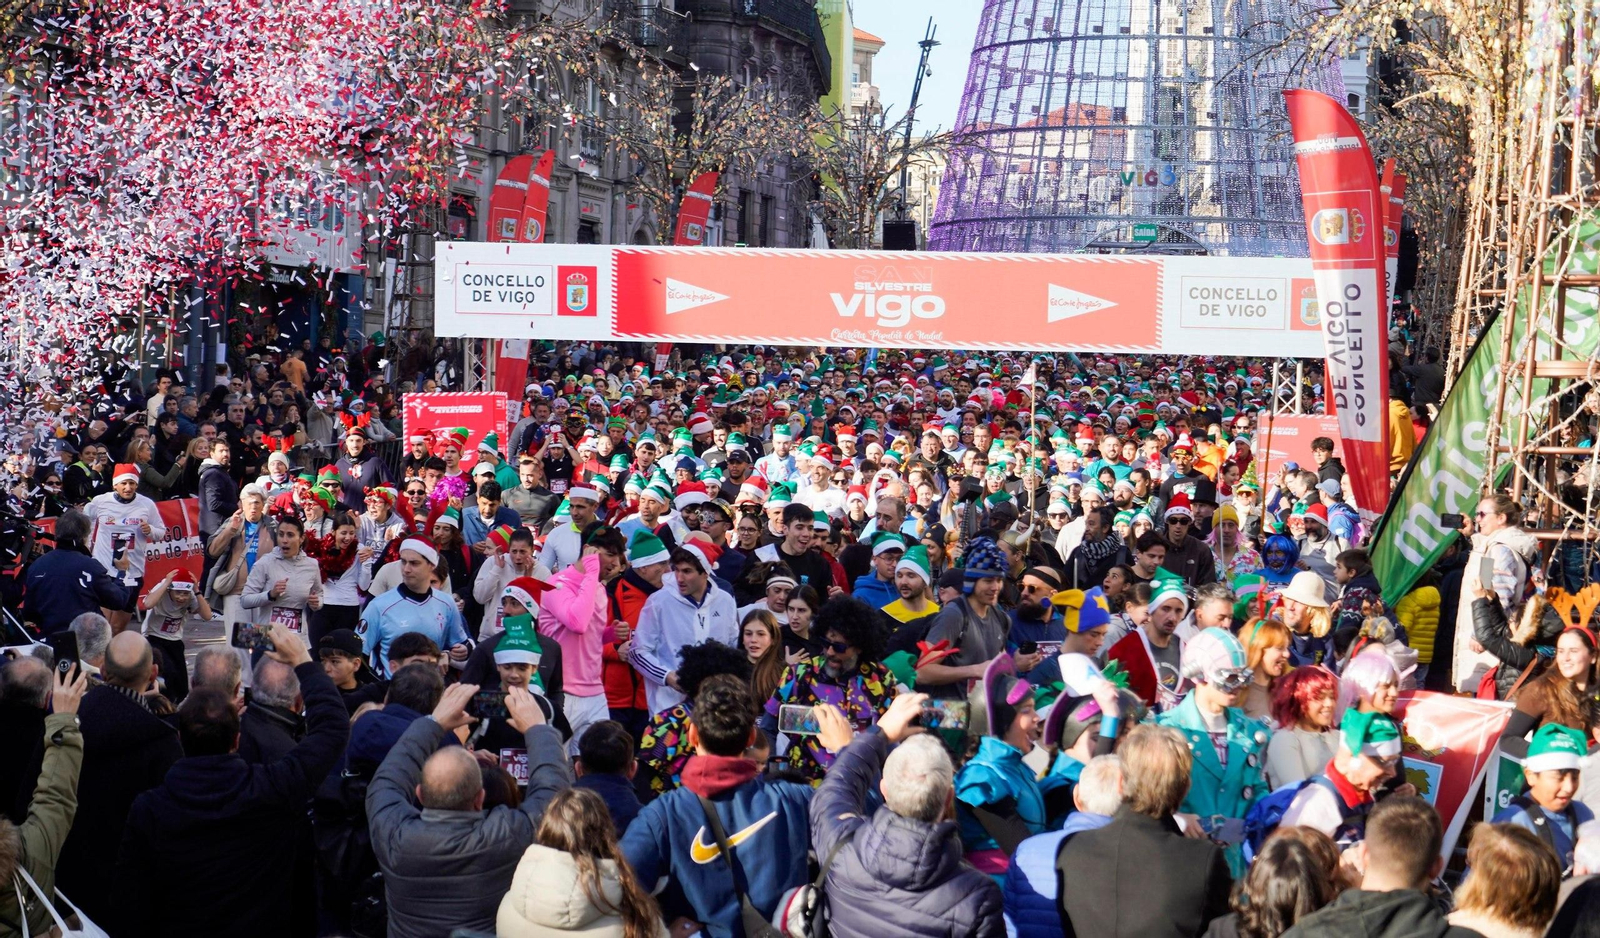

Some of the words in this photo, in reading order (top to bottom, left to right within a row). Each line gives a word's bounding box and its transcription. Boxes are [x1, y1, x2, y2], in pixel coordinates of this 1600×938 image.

[463, 274, 545, 287] CONCELLO
[854, 282, 932, 291] SILVESTRE
[472, 290, 492, 302] DE
[498, 291, 535, 303] VIGO
[1189, 287, 1277, 301] CONCELLO
[829, 292, 946, 328] vigo
[1199, 304, 1220, 316] DE
[1227, 304, 1267, 317] VIGO
[165, 543, 182, 559] de
